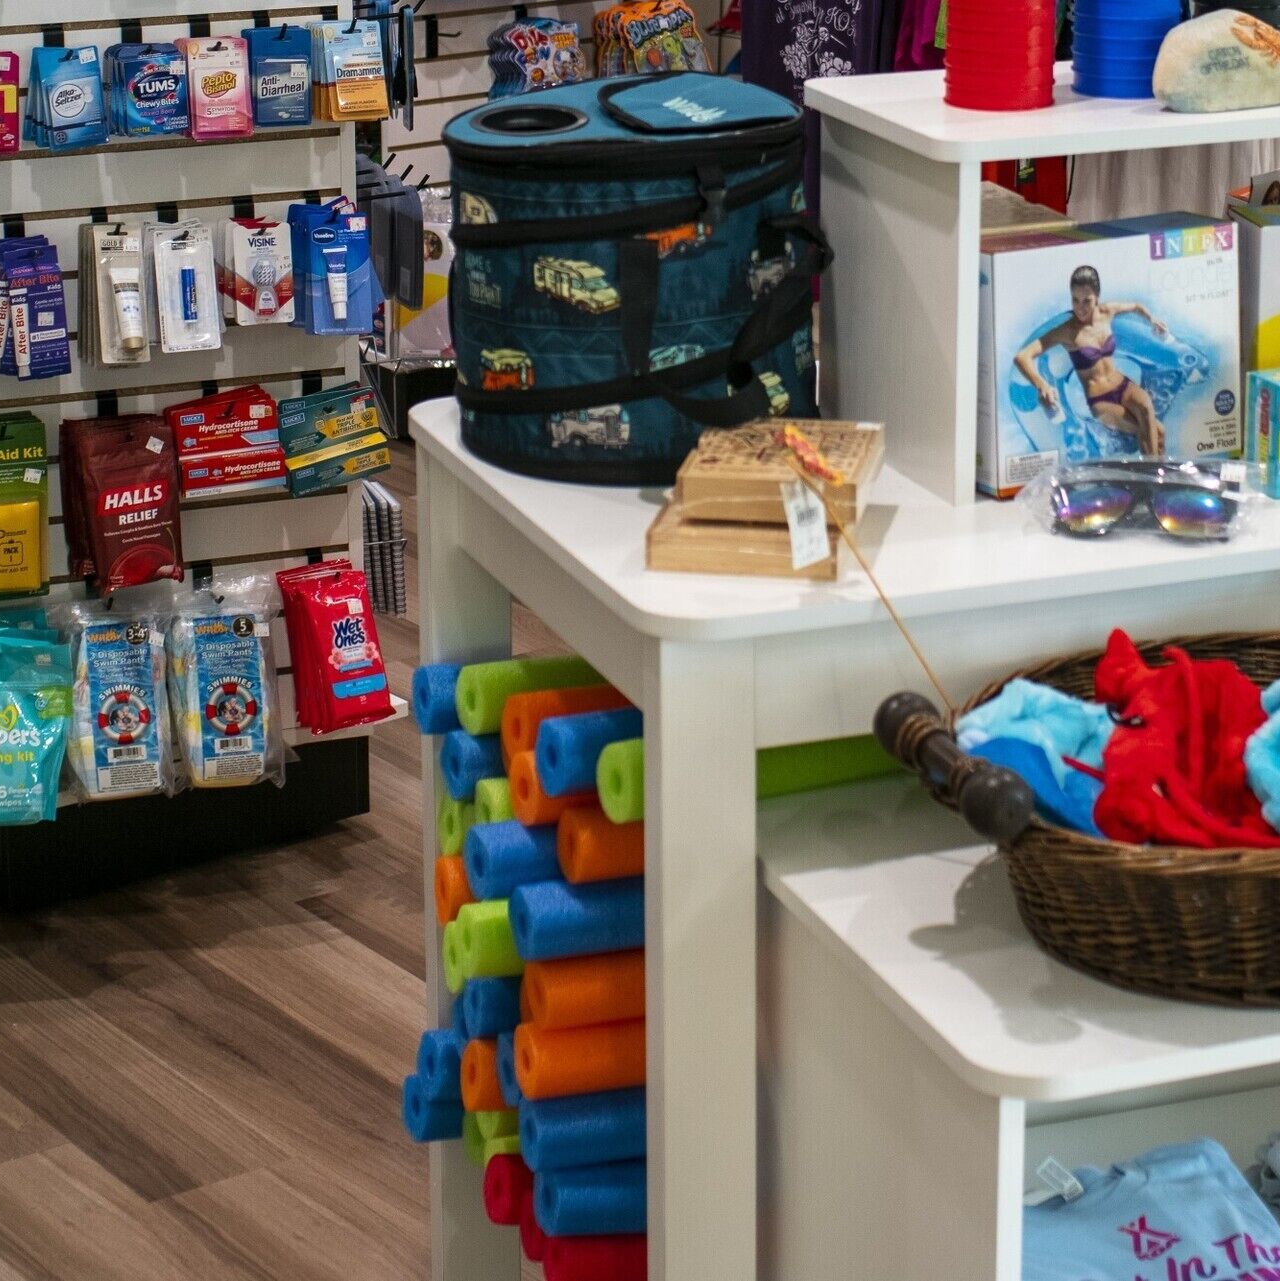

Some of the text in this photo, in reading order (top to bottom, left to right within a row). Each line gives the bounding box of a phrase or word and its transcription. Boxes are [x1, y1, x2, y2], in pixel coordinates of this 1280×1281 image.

[201, 71, 236, 88] Pepto-
[336, 67, 382, 78] Dramamine
[138, 79, 176, 94] TUMS
[206, 80, 237, 95] Bismol
[261, 76, 280, 87] Anti-
[261, 81, 305, 97] Diarrheal
[54, 93, 83, 109] Seltzer
[136, 100, 160, 109] Chewy
[248, 236, 277, 248] VISINE
[1154, 227, 1231, 258] INTEX
[10, 273, 62, 289] After Bite
[16, 307, 28, 356] After Bite
[198, 418, 259, 434] Hydrocortisone
[238, 424, 259, 432] CREAM
[1197, 436, 1238, 452] One Float
[22, 446, 45, 459] Kit
[224, 459, 281, 474] Hydrocortisone
[104, 484, 163, 511] HALLS
[118, 508, 159, 526] RELIEF
[239, 619, 248, 633] 5
[333, 617, 363, 636] Wet
[205, 640, 256, 652] Disposable
[334, 630, 366, 649] Ones
[93, 655, 146, 667] Swim Pants
[97, 648, 148, 661] Disposable
[201, 648, 254, 660] Swim Pants
[97, 684, 146, 702] SWIMMIES
[206, 676, 256, 695] SWIMMIES
[17, 750, 35, 762] kit
